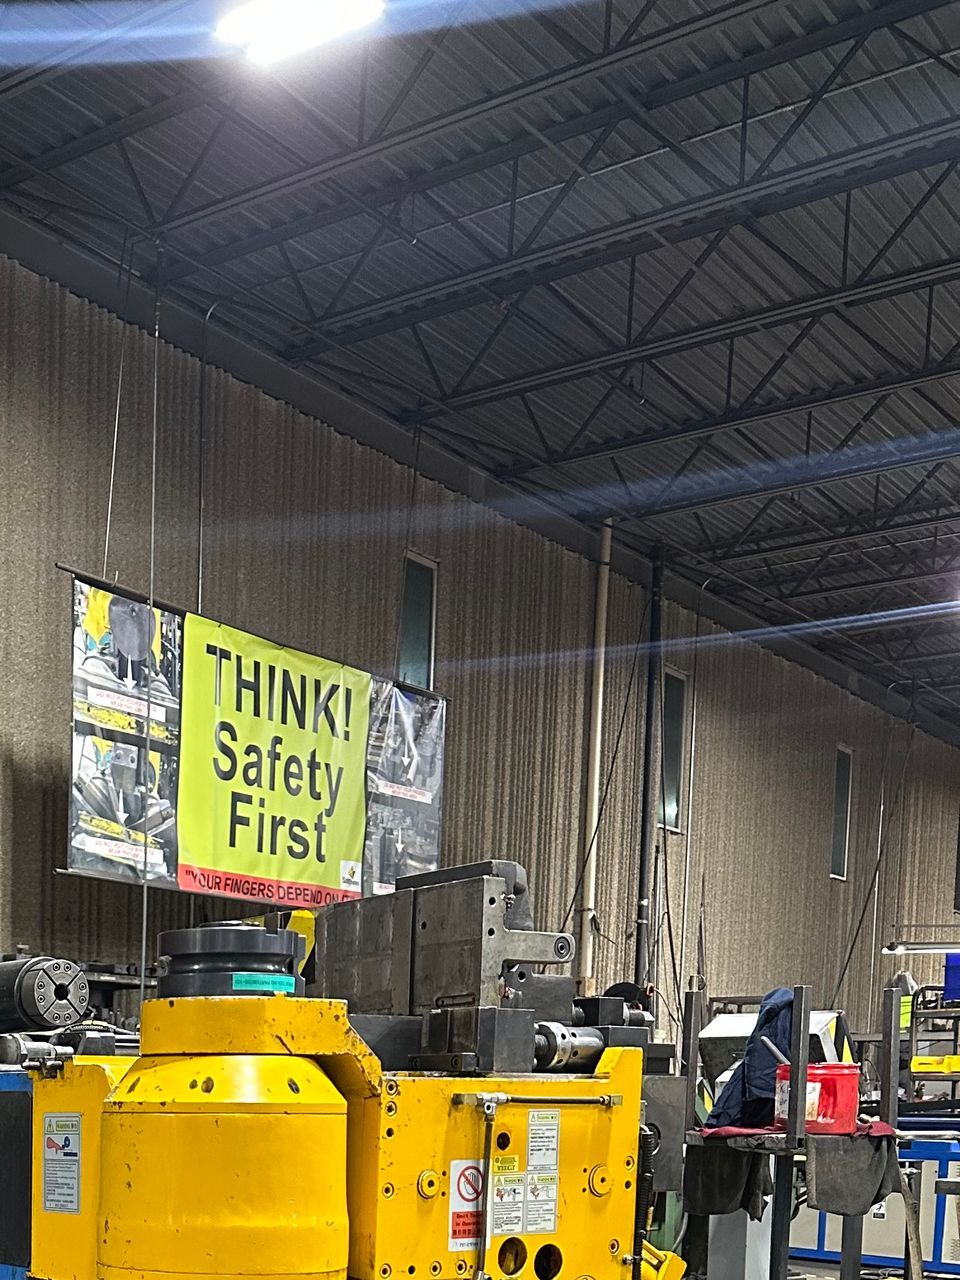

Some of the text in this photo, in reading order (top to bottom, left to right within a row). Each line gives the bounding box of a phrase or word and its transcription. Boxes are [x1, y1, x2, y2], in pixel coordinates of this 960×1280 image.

[206, 644, 353, 742] THINK!
[212, 721, 344, 818] Safety
[228, 791, 327, 863] First
[223, 877, 274, 898] FINGERS
[277, 885, 323, 905] DEPEND
